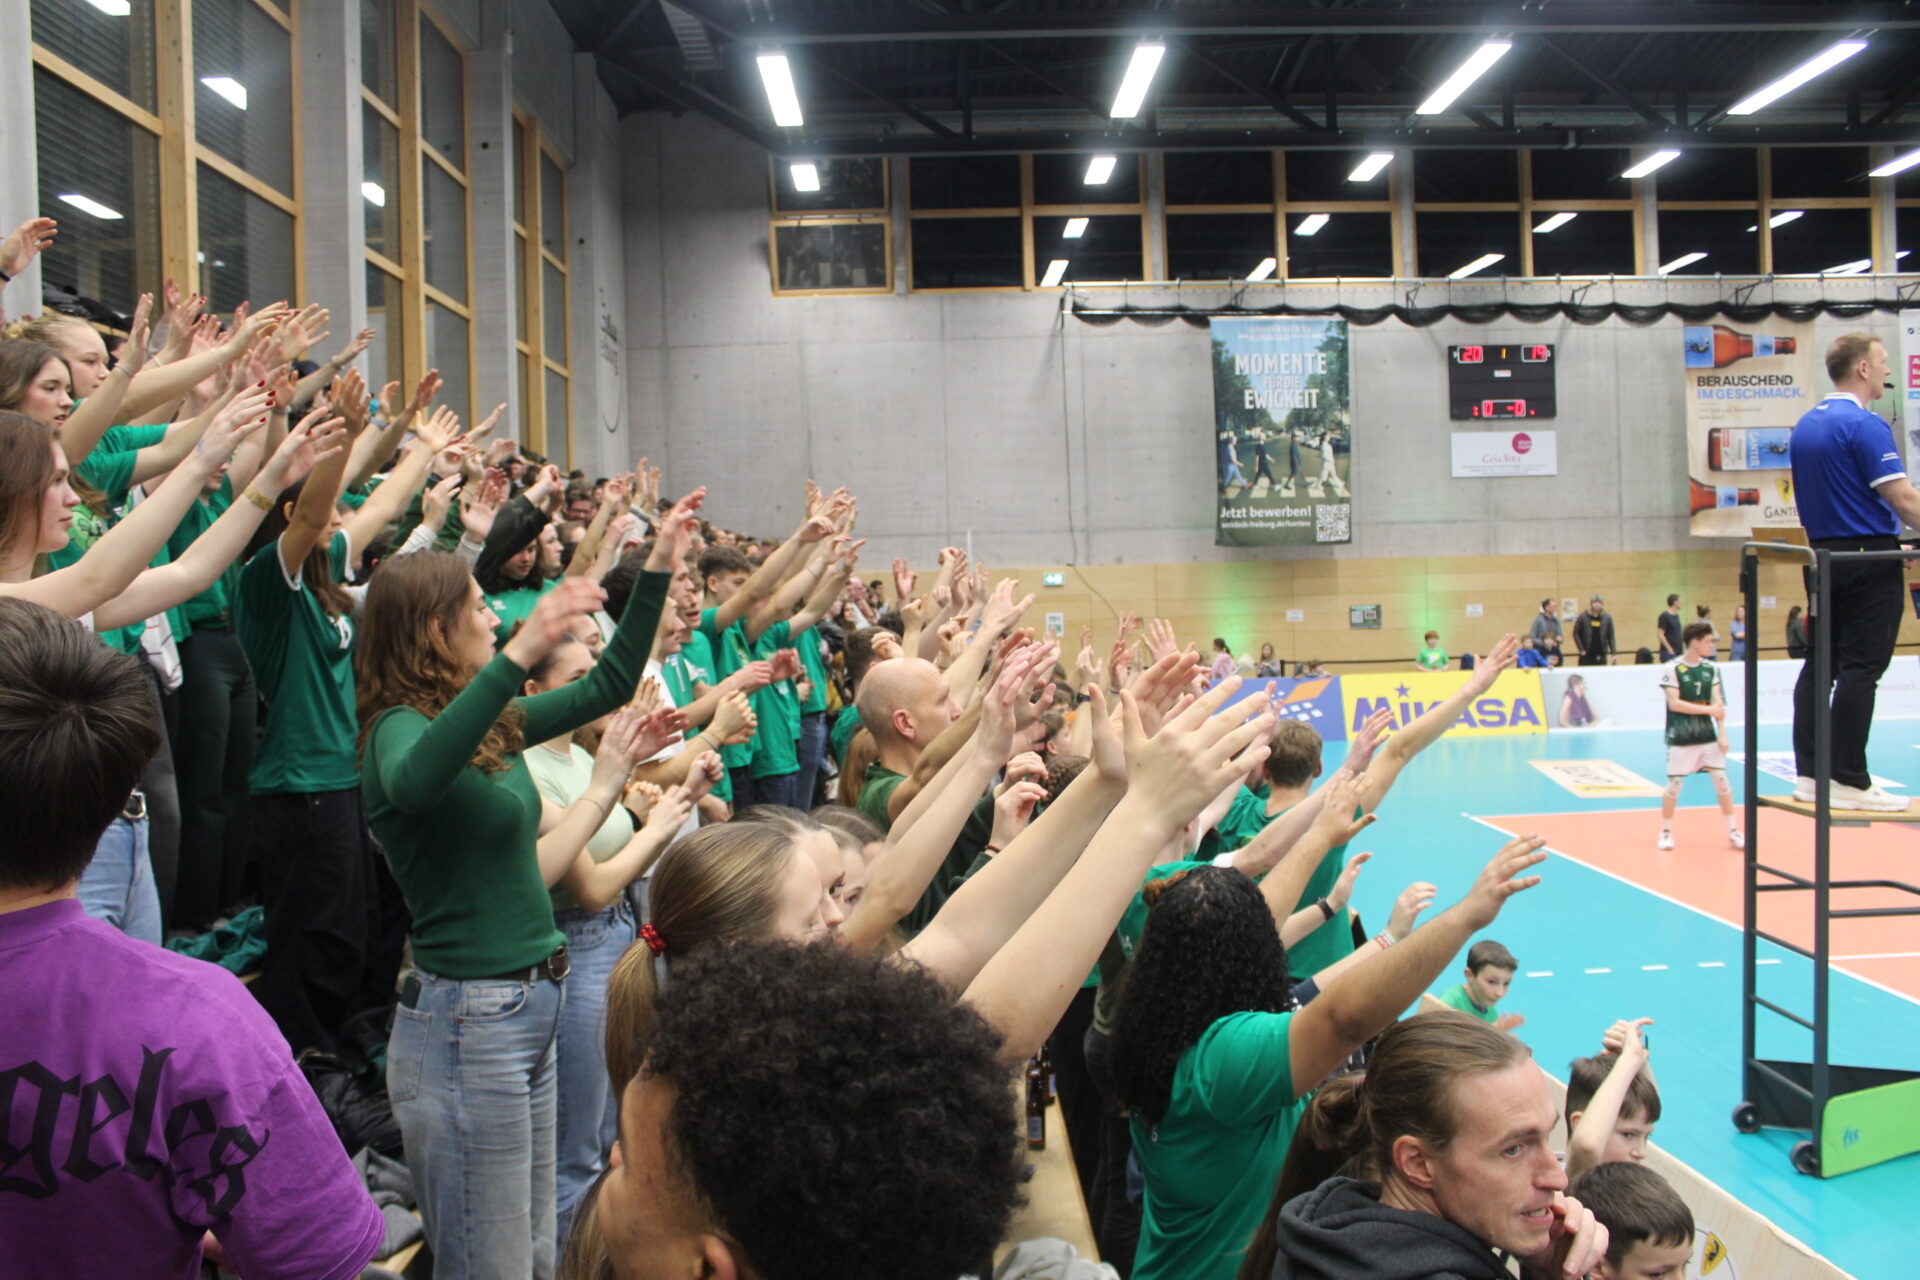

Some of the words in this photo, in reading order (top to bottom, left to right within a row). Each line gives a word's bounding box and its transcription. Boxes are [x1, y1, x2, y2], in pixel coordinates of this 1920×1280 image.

[1462, 346, 1483, 362] 20
[1531, 345, 1546, 360] 19
[1234, 352, 1328, 375] MOMENTE
[1697, 375, 1793, 387] BERAUSCHEND
[1244, 389, 1320, 409] EWIGKEIT
[1697, 389, 1713, 400] IM
[1715, 387, 1806, 400] GESCHMACK.
[1220, 506, 1247, 518] Jetzt
[1249, 505, 1312, 518] bewerben!
[1764, 505, 1799, 519] GANTE
[1694, 681, 1703, 696] 7
